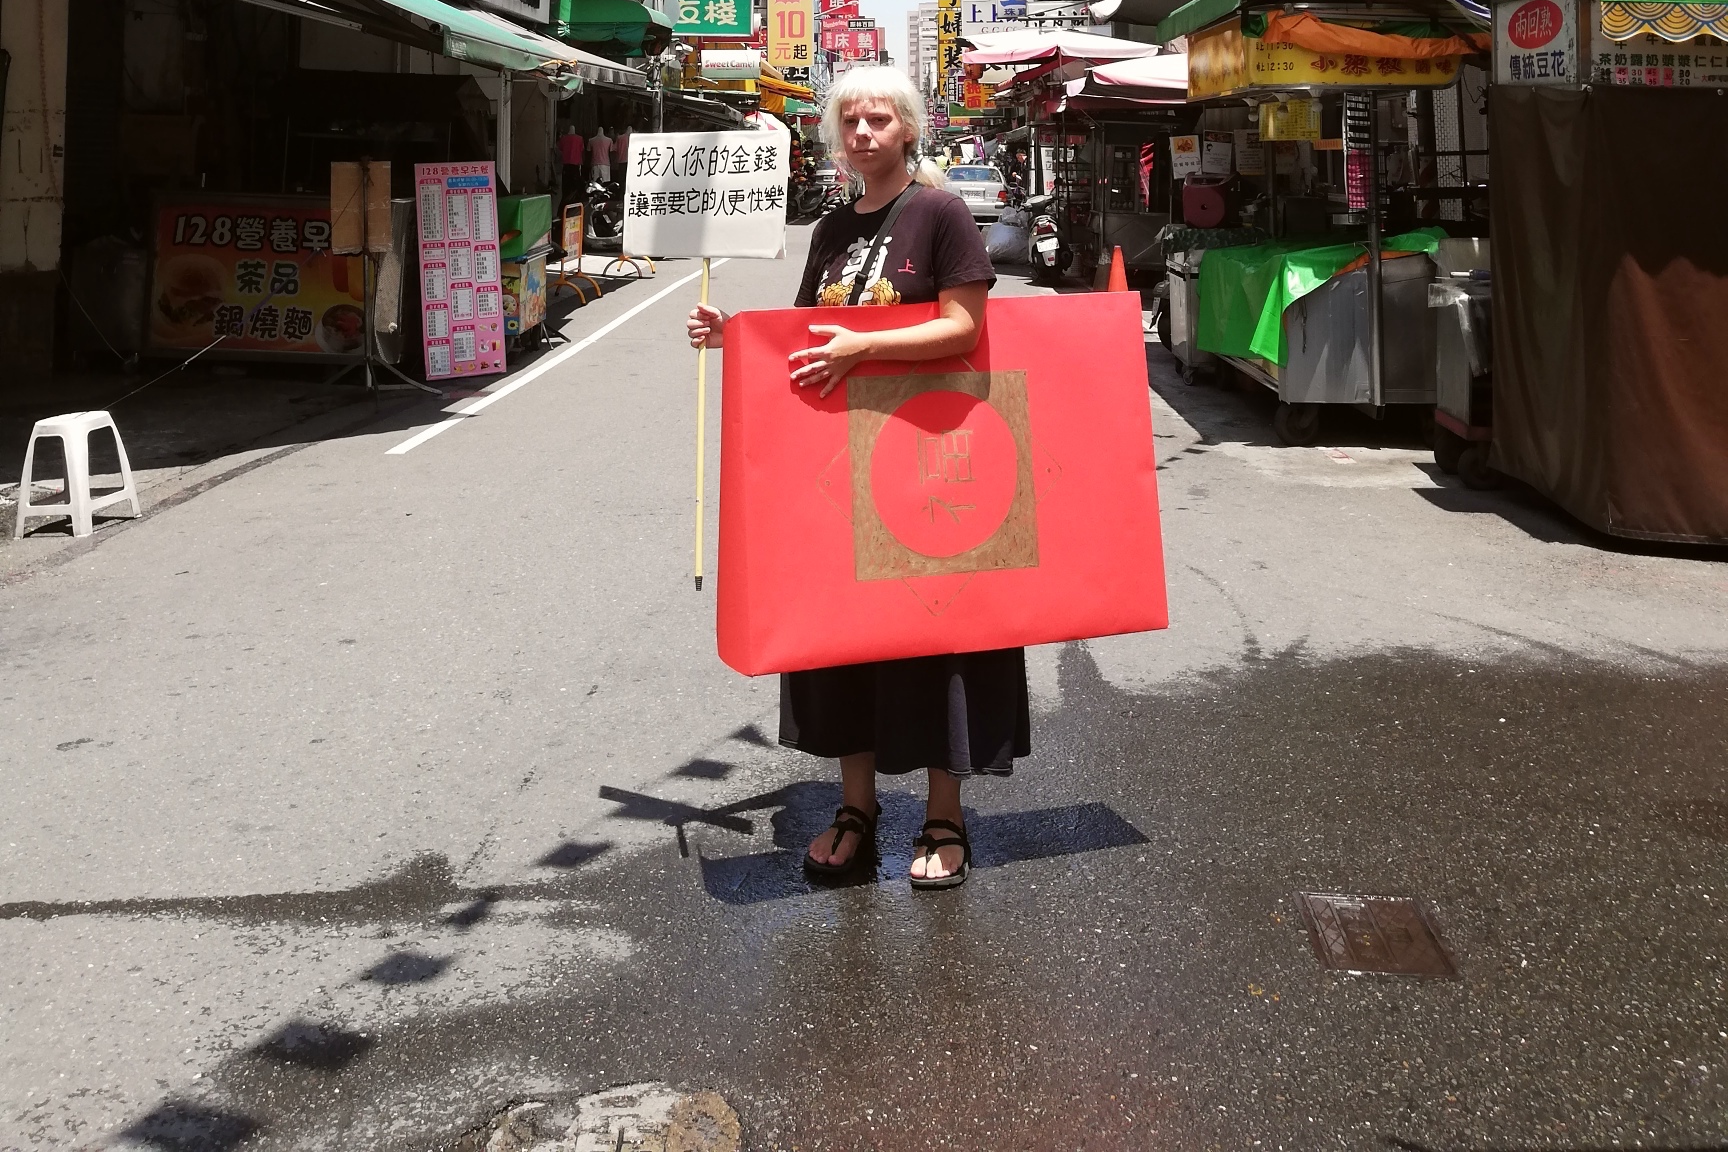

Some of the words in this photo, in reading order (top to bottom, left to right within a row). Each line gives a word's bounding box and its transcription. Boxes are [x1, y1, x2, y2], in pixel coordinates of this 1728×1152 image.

[776, 10, 805, 39] 10
[1515, 6, 1552, 40] 兩回熟
[775, 43, 808, 60] 元起
[835, 33, 873, 48] 床墊
[705, 60, 729, 68] Sweet
[730, 60, 755, 68] Camel
[1509, 49, 1566, 80] 傳統豆花
[637, 145, 778, 177] 投入你的金錢
[628, 185, 784, 217] 讓需要它的人更快樂
[174, 215, 330, 253] 128營養早
[235, 259, 299, 296] 茶品
[897, 258, 916, 274] 上
[213, 306, 313, 340] 鍋燒麵
